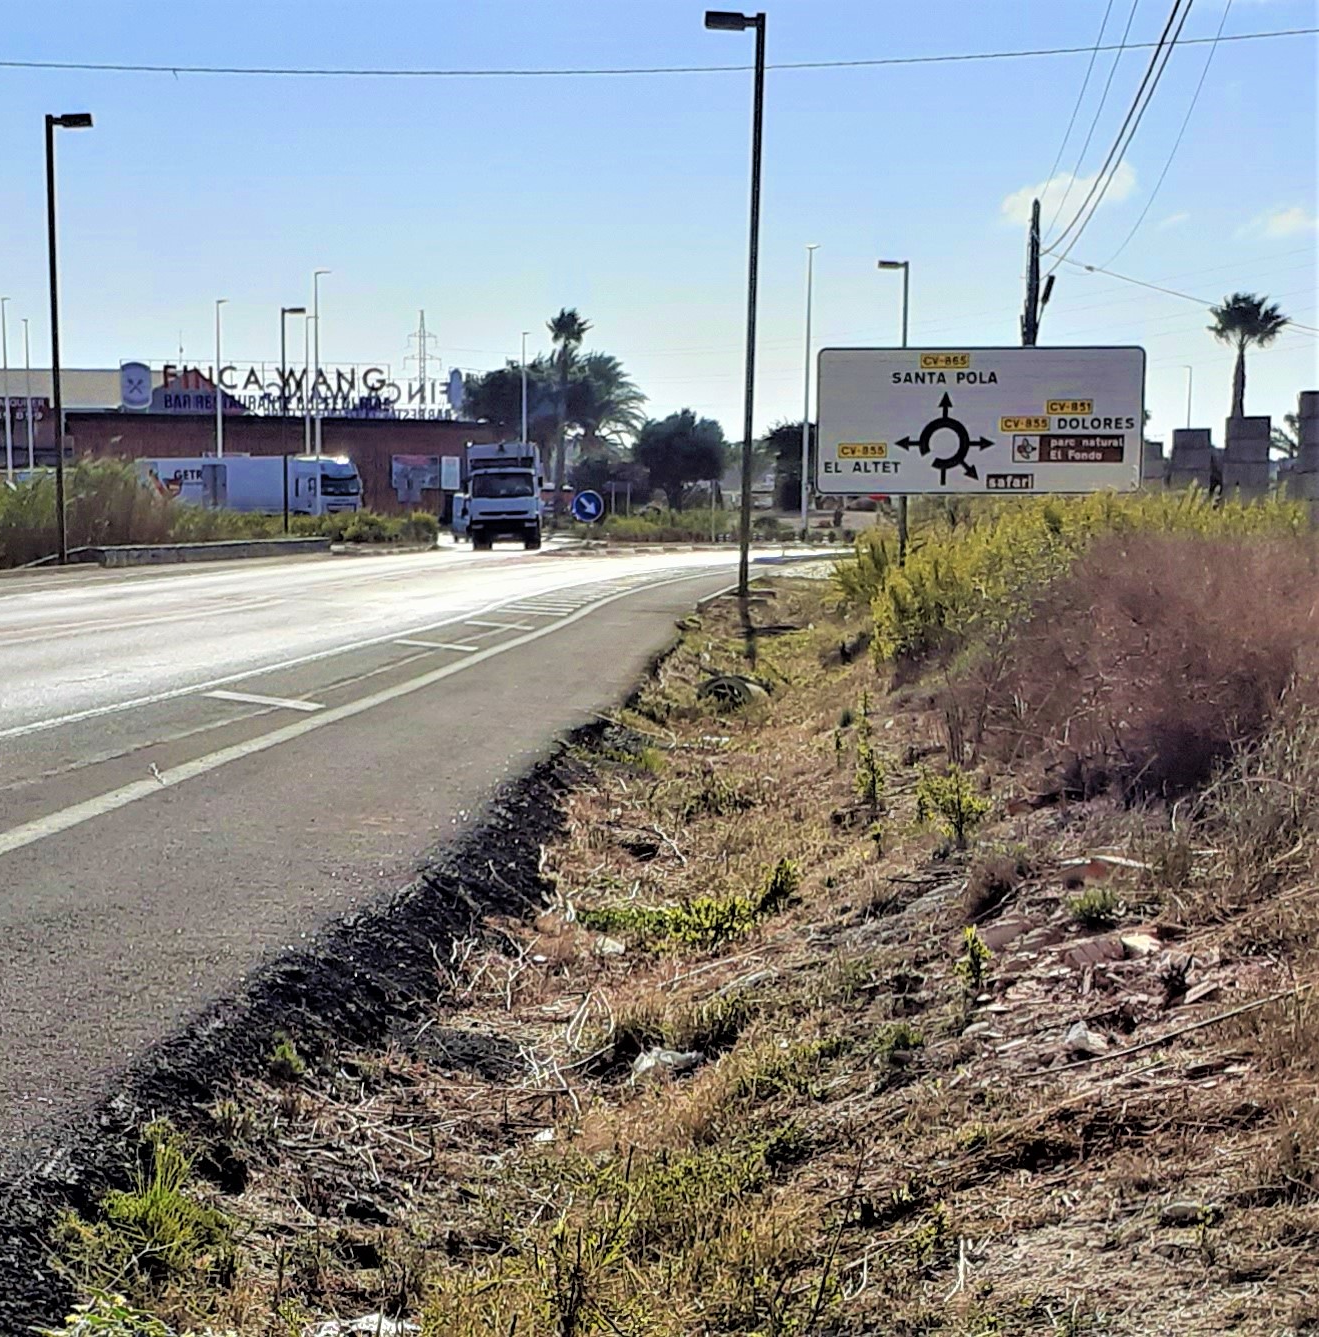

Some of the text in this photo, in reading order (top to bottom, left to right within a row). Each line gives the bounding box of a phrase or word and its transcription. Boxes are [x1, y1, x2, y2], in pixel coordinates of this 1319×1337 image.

[923, 355, 967, 366] CV-865
[163, 364, 387, 391] FINCA WANG
[892, 372, 998, 384] SANTA POLA
[1049, 402, 1092, 412] CV-851
[1057, 417, 1135, 430] DOLORES
[1050, 437, 1123, 448] parc natural
[1049, 450, 1103, 460] El Fondo
[824, 461, 901, 473] EL ALTET
[988, 476, 1031, 488] safari
